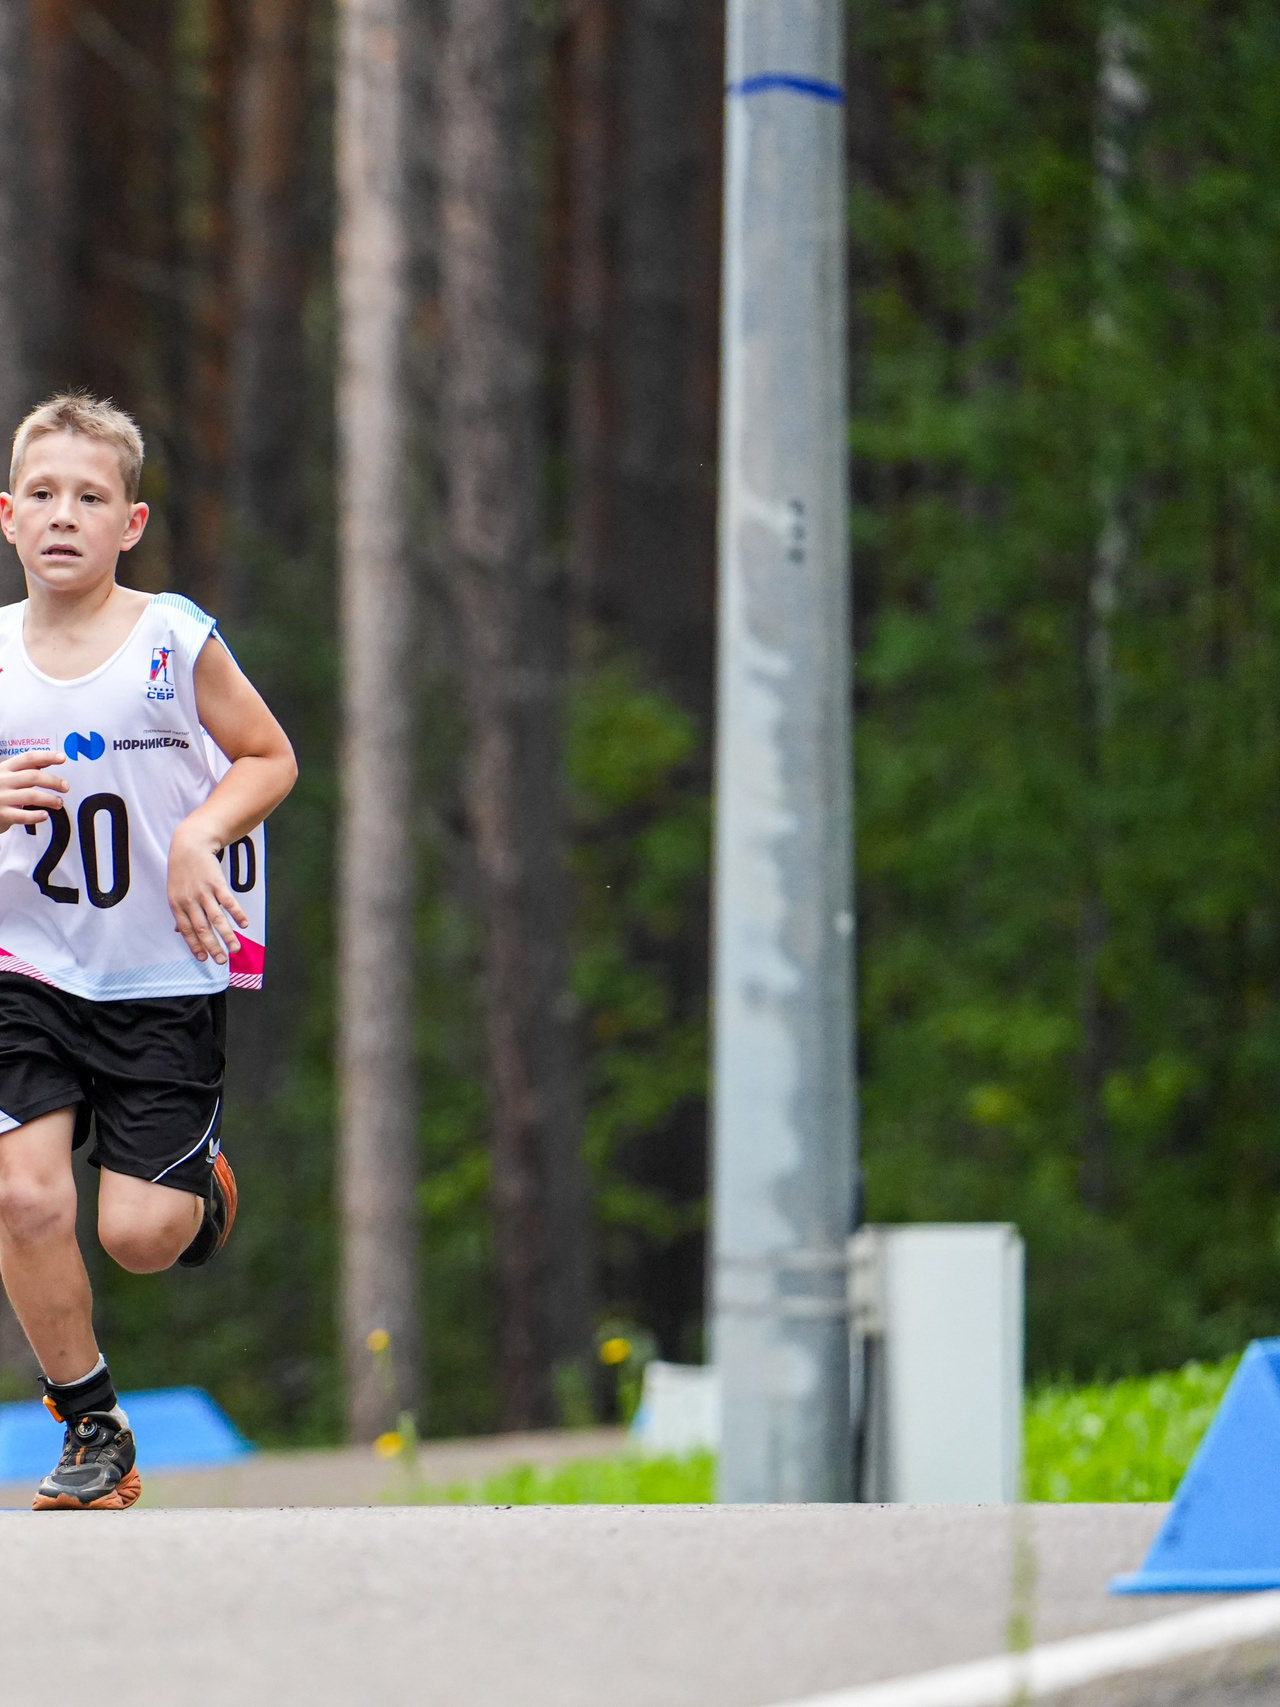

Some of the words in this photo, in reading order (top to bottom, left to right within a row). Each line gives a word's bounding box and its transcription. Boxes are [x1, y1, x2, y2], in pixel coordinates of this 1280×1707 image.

[146, 691, 175, 701] СБР
[8, 737, 51, 747] UNIVERSIADE
[113, 737, 190, 751] НОРНИКЕЛЬ
[22, 792, 131, 909] 20
[216, 834, 256, 893] 0
